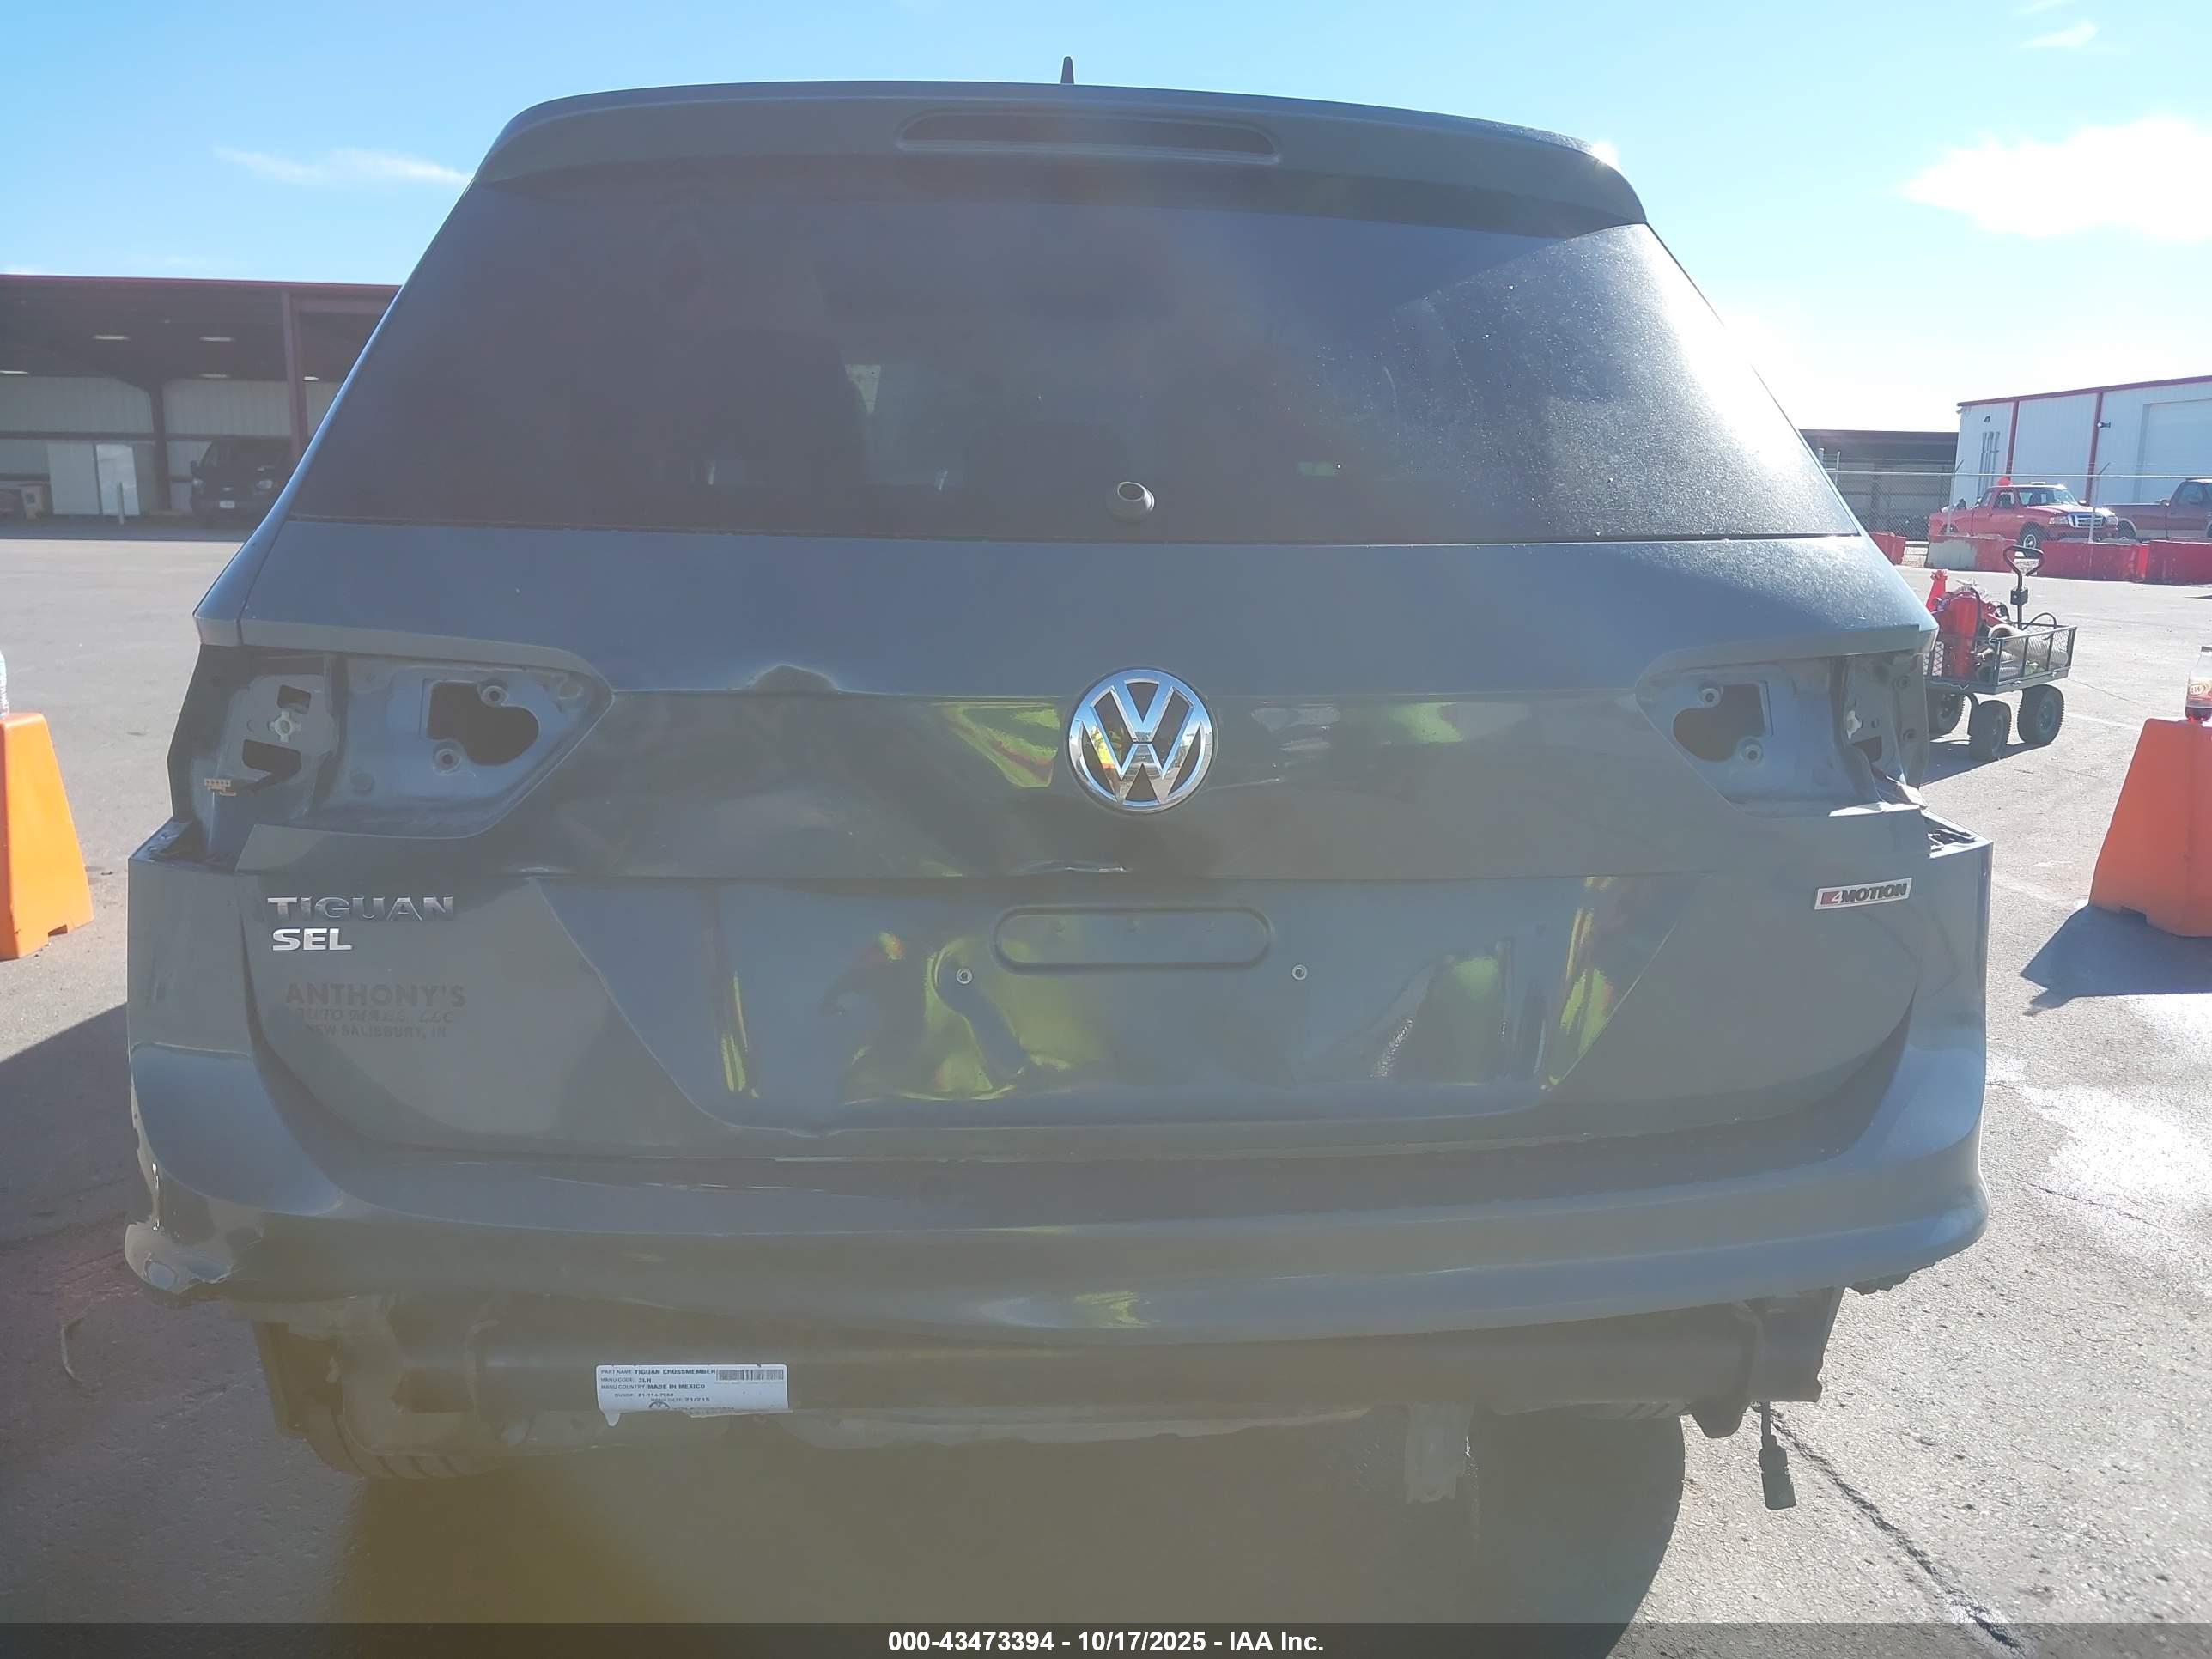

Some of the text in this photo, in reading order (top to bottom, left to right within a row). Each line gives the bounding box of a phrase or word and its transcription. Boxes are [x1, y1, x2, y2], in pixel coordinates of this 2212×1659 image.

[1831, 884, 1907, 904] 4MOTION
[267, 896, 453, 921] TIGUAN
[272, 928, 352, 951] SEL
[286, 982, 465, 1007] ANTHONY'S
